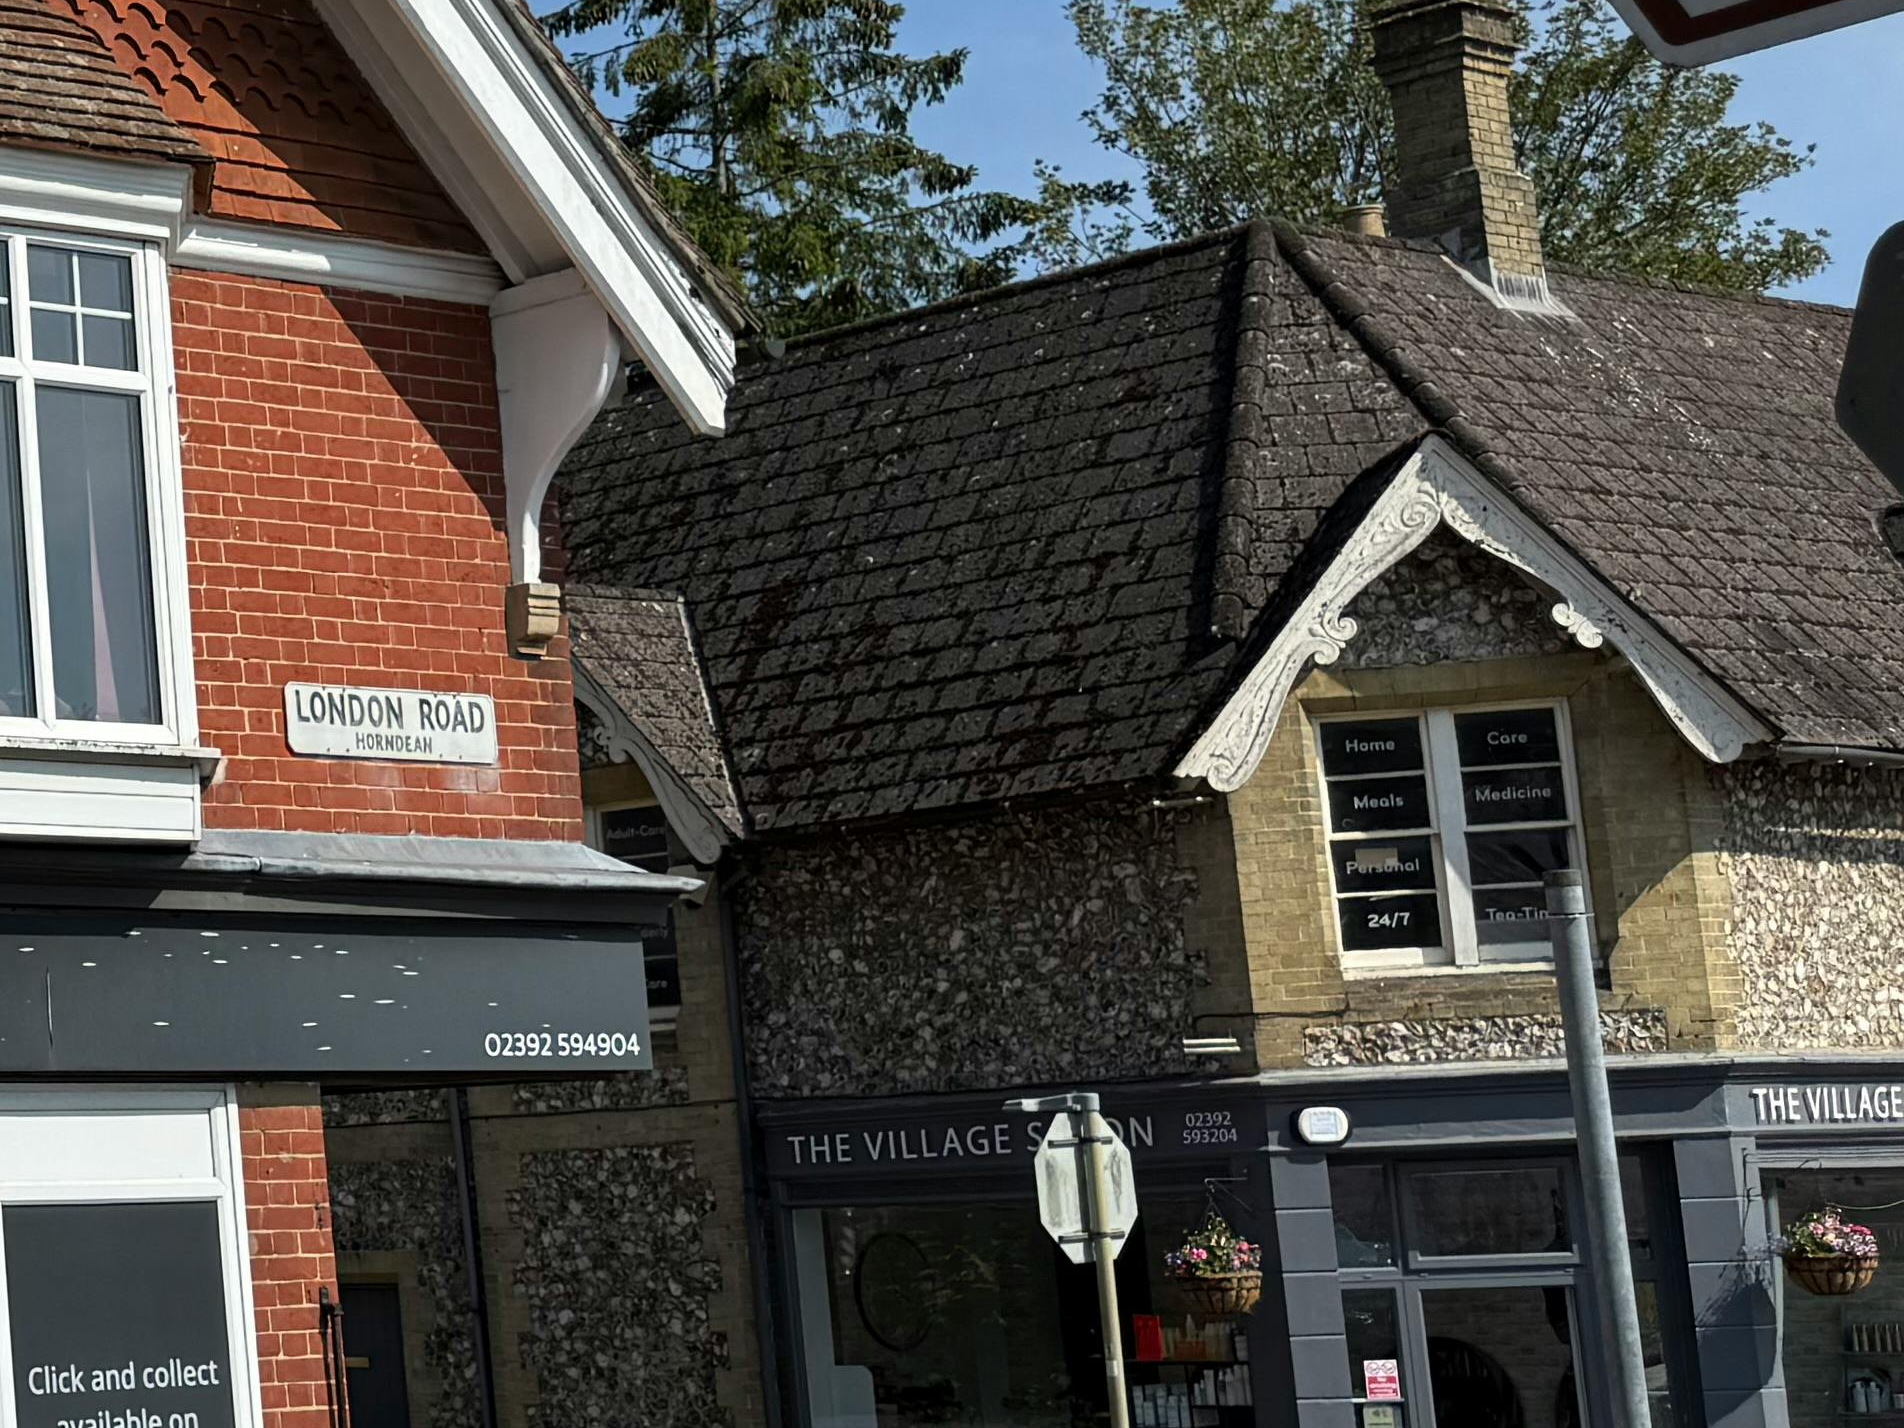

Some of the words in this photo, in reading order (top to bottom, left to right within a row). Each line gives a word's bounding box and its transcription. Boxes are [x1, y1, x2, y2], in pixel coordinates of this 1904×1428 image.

[295, 689, 404, 729] LONDON
[419, 698, 485, 733] ROAD
[355, 732, 433, 753] HORNDEAN
[1346, 739, 1395, 753] Home
[1487, 731, 1528, 745] Care
[1354, 794, 1404, 810] Meals
[1475, 785, 1552, 802] Medicine
[1346, 859, 1420, 875] Personal
[1367, 912, 1410, 929] 24/7
[485, 1033, 552, 1057] 02392
[557, 1033, 640, 1057] 594904
[1752, 1088, 1801, 1120] THE
[1805, 1086, 1904, 1120] VILLAGE
[1185, 1111, 1232, 1127] 02392
[787, 1133, 852, 1165] THE
[863, 1124, 1012, 1160] VILLAGE
[1183, 1128, 1238, 1144] 593204
[28, 1364, 85, 1395] Click
[91, 1361, 136, 1391] and
[142, 1358, 219, 1389] collect
